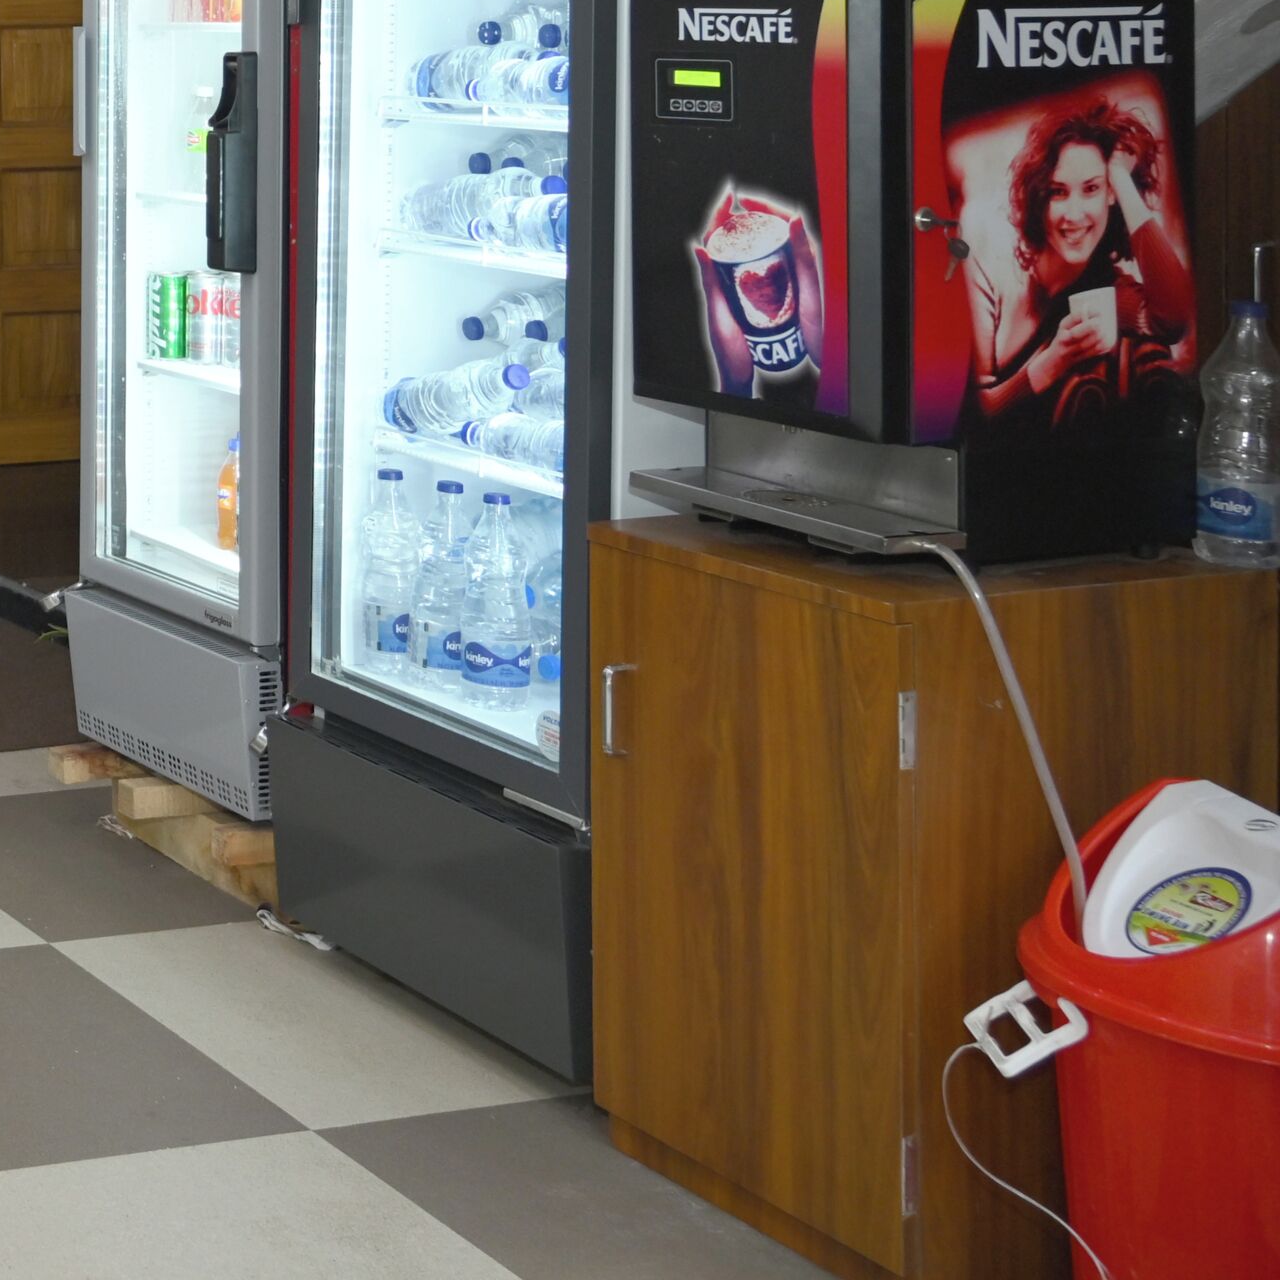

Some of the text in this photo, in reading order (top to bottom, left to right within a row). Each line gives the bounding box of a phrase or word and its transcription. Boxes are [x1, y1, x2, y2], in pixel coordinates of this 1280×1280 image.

[678, 7, 794, 44] NESCAFÉ
[976, 2, 1168, 69] NESCAFÉ
[1209, 496, 1253, 517] kinley
[465, 650, 494, 667] kinley
